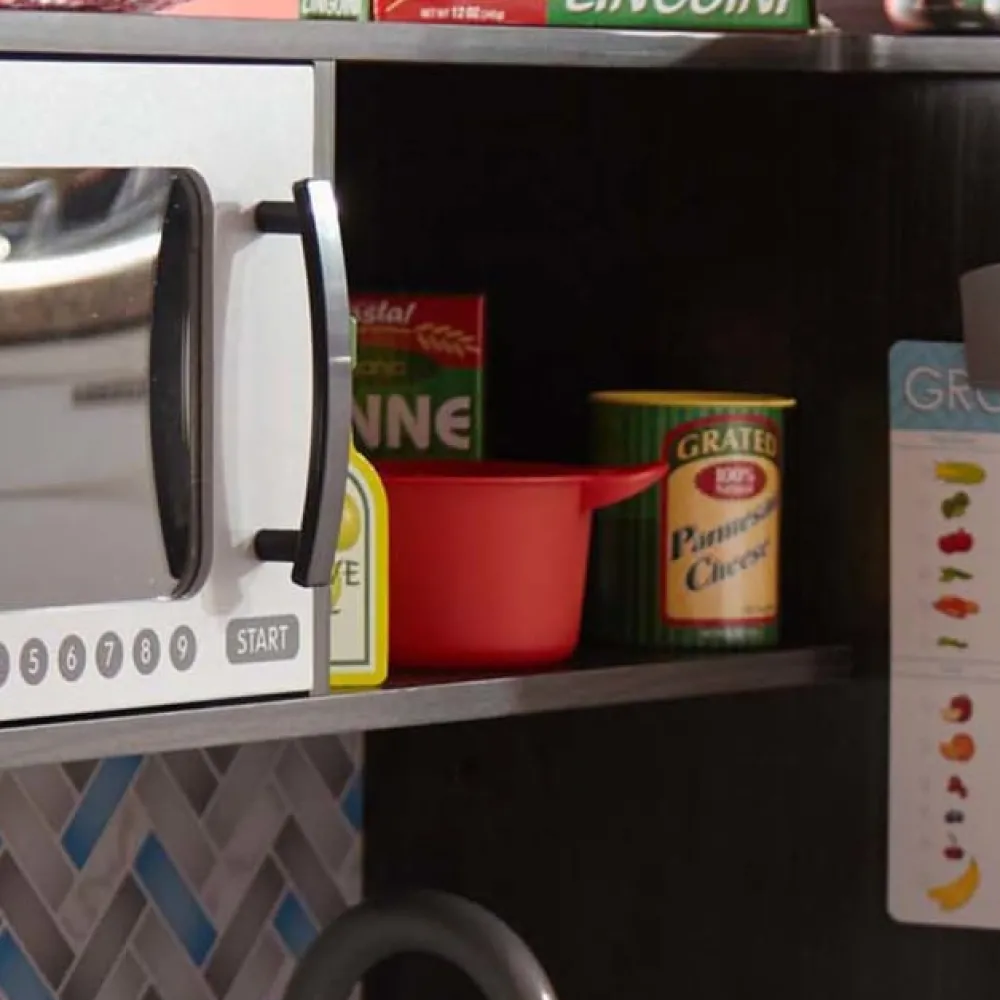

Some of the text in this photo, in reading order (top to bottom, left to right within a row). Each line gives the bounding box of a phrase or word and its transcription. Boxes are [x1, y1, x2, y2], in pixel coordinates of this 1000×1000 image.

[677, 427, 778, 460] GRATED
[27, 625, 290, 674] 5 6 7 8 9 START
